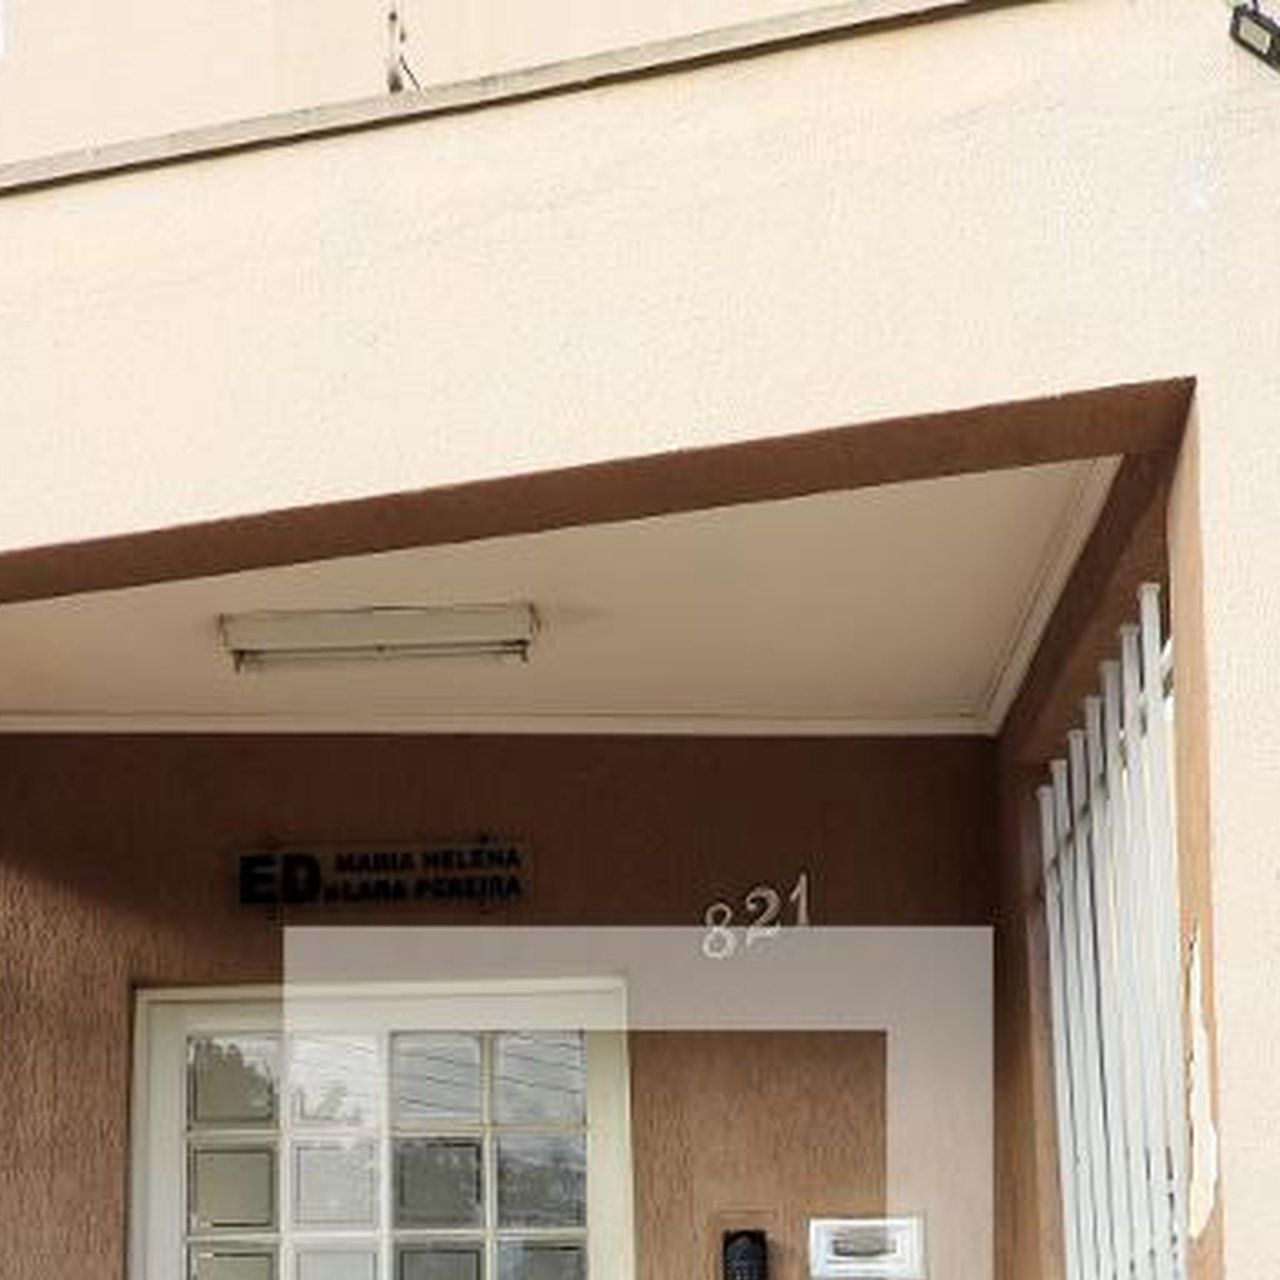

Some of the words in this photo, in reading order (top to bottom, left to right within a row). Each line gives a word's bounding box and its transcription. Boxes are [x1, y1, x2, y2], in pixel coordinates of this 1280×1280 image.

[335, 852, 416, 873] MARIA
[415, 875, 522, 900] PEREIRA
[702, 873, 808, 960] 821
